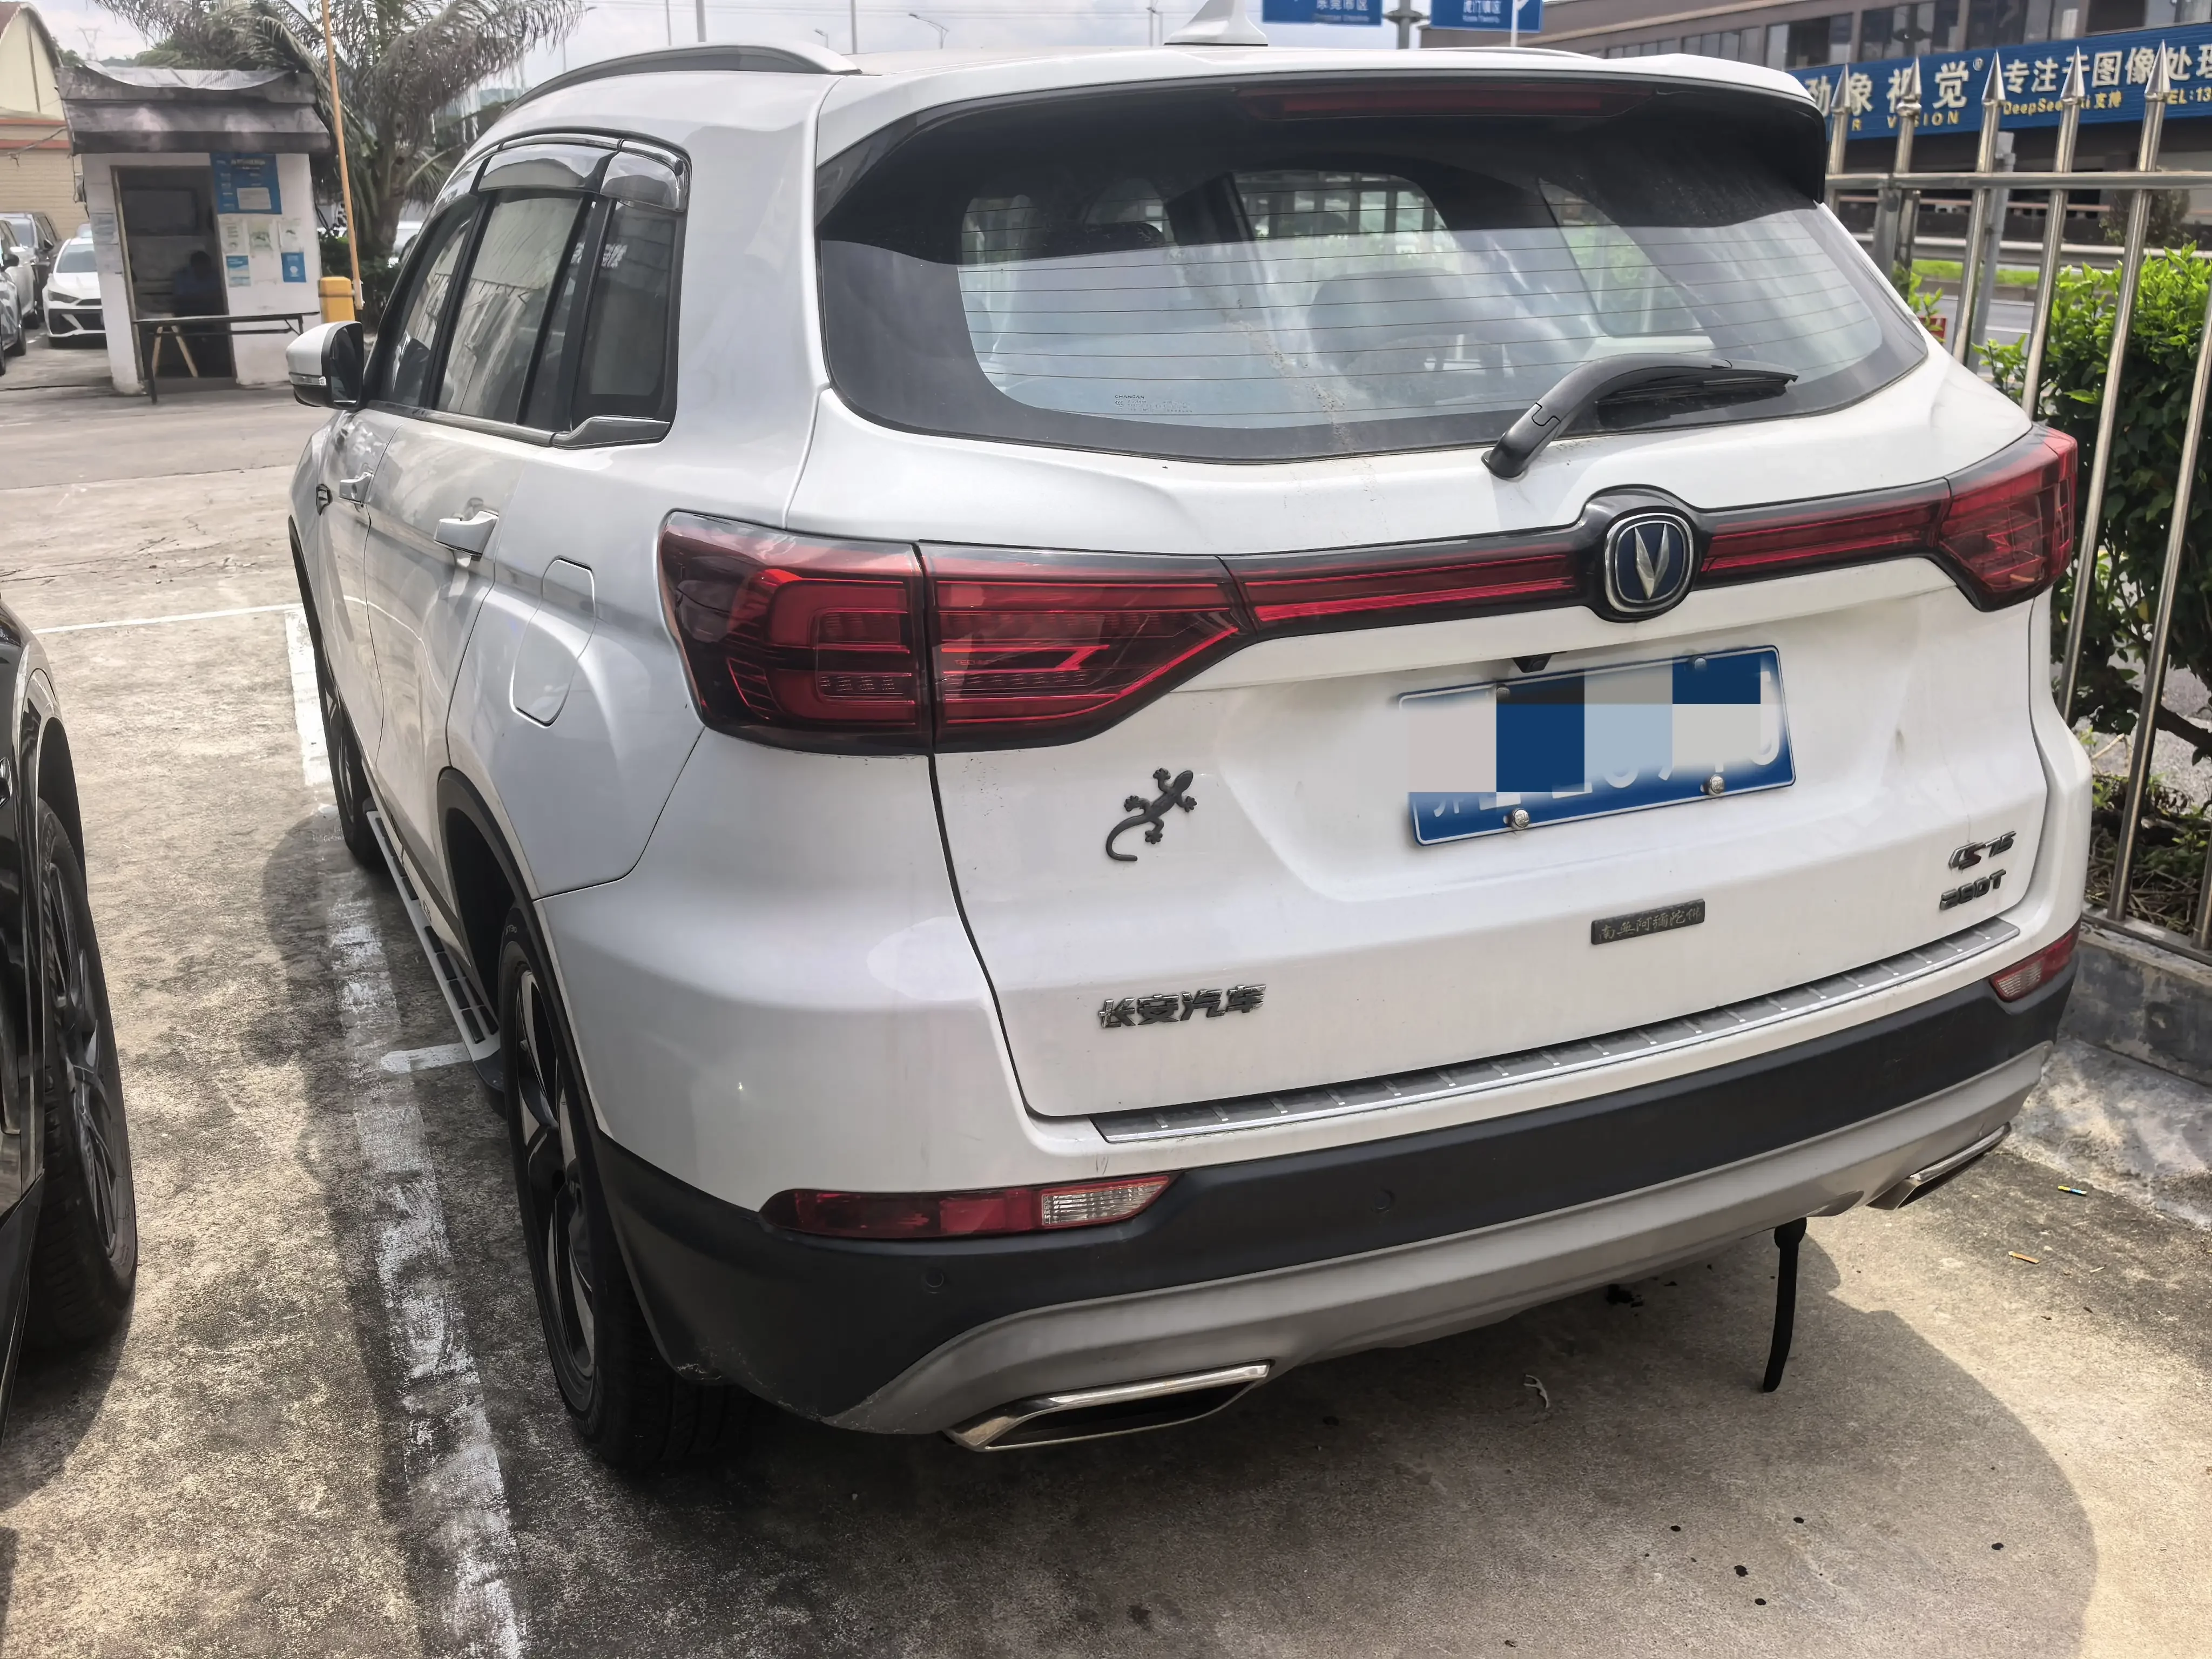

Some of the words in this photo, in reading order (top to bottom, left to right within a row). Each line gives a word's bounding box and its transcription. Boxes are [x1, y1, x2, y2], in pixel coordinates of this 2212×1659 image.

[2003, 98, 2064, 117] DeepSee
[1939, 868, 2007, 911] 280T
[1098, 984, 1267, 1028] 长安汽车
